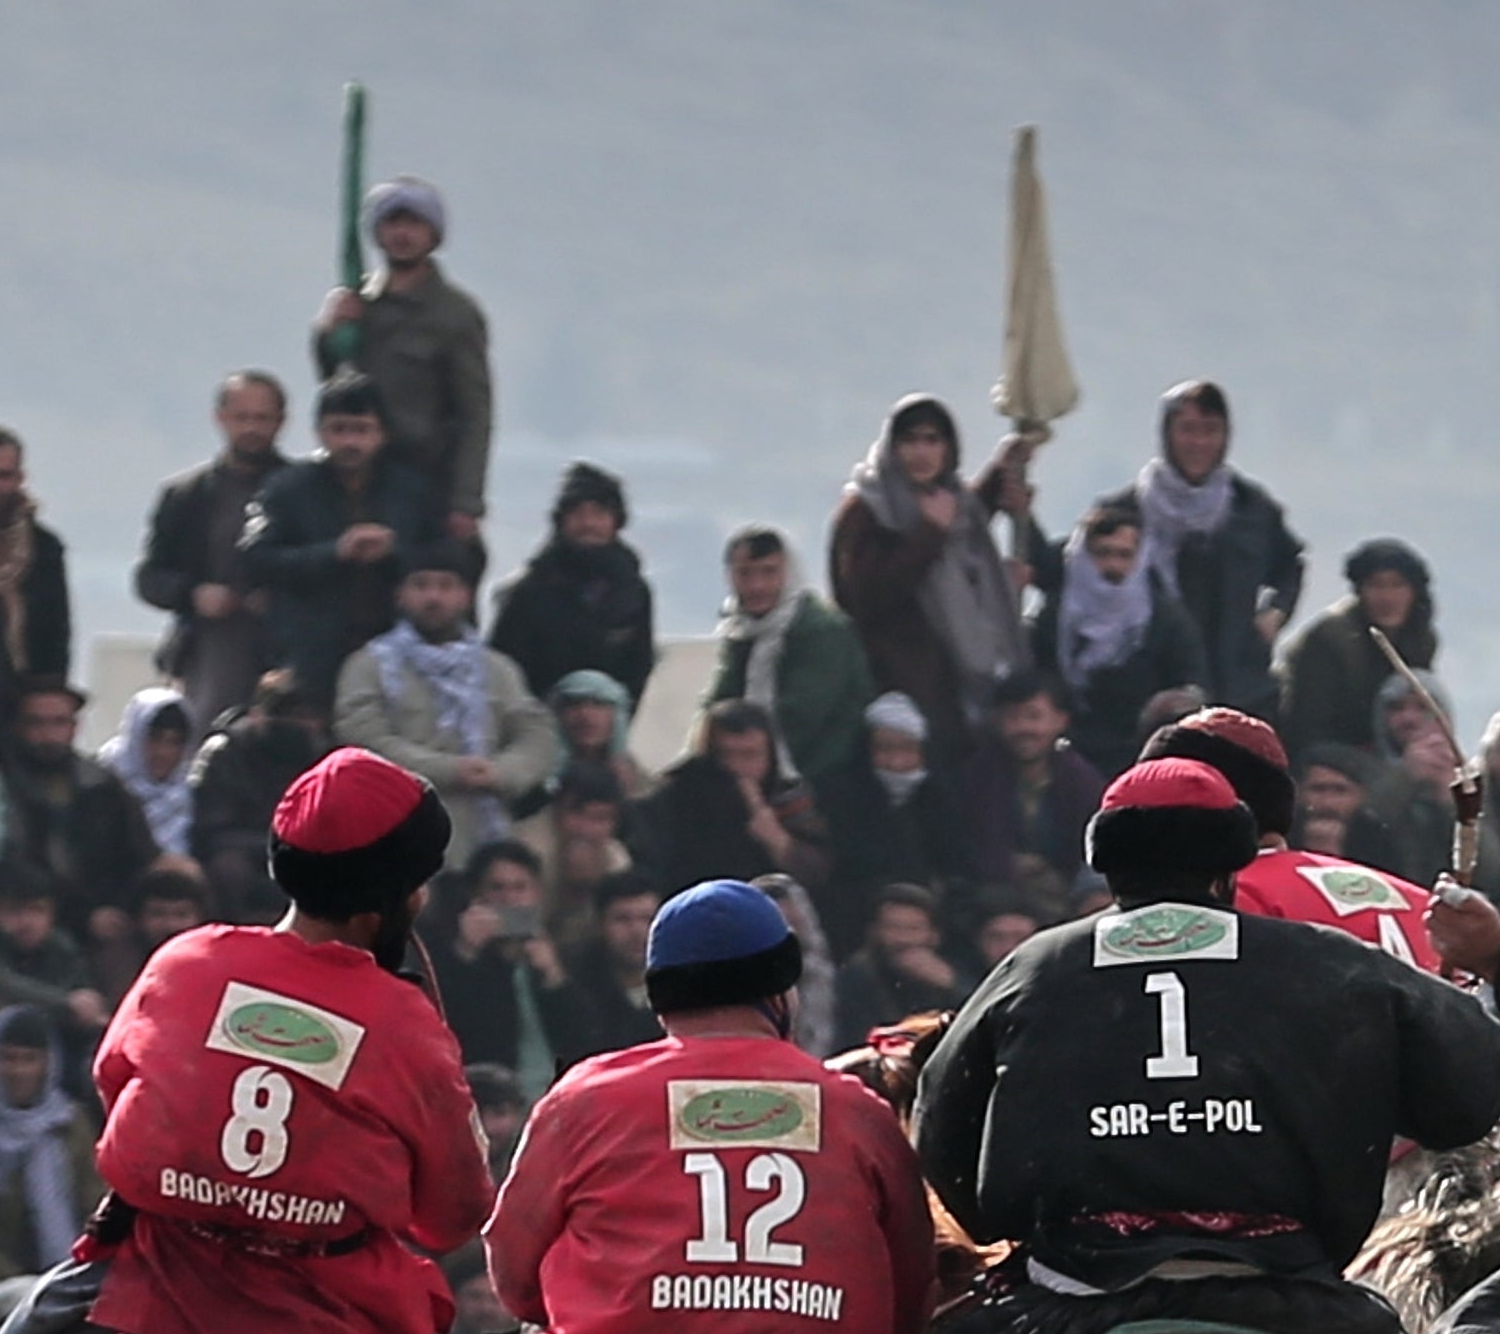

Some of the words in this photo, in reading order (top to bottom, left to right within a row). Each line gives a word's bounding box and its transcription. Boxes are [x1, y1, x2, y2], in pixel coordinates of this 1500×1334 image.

[1144, 971, 1199, 1078] 1
[221, 1065, 293, 1178] 8
[1090, 1099, 1262, 1137] SAR-E-POL
[160, 1167, 345, 1225] BADAKHSHAN
[684, 1152, 804, 1266] 12
[652, 1275, 843, 1321] BADAKHSHAN
